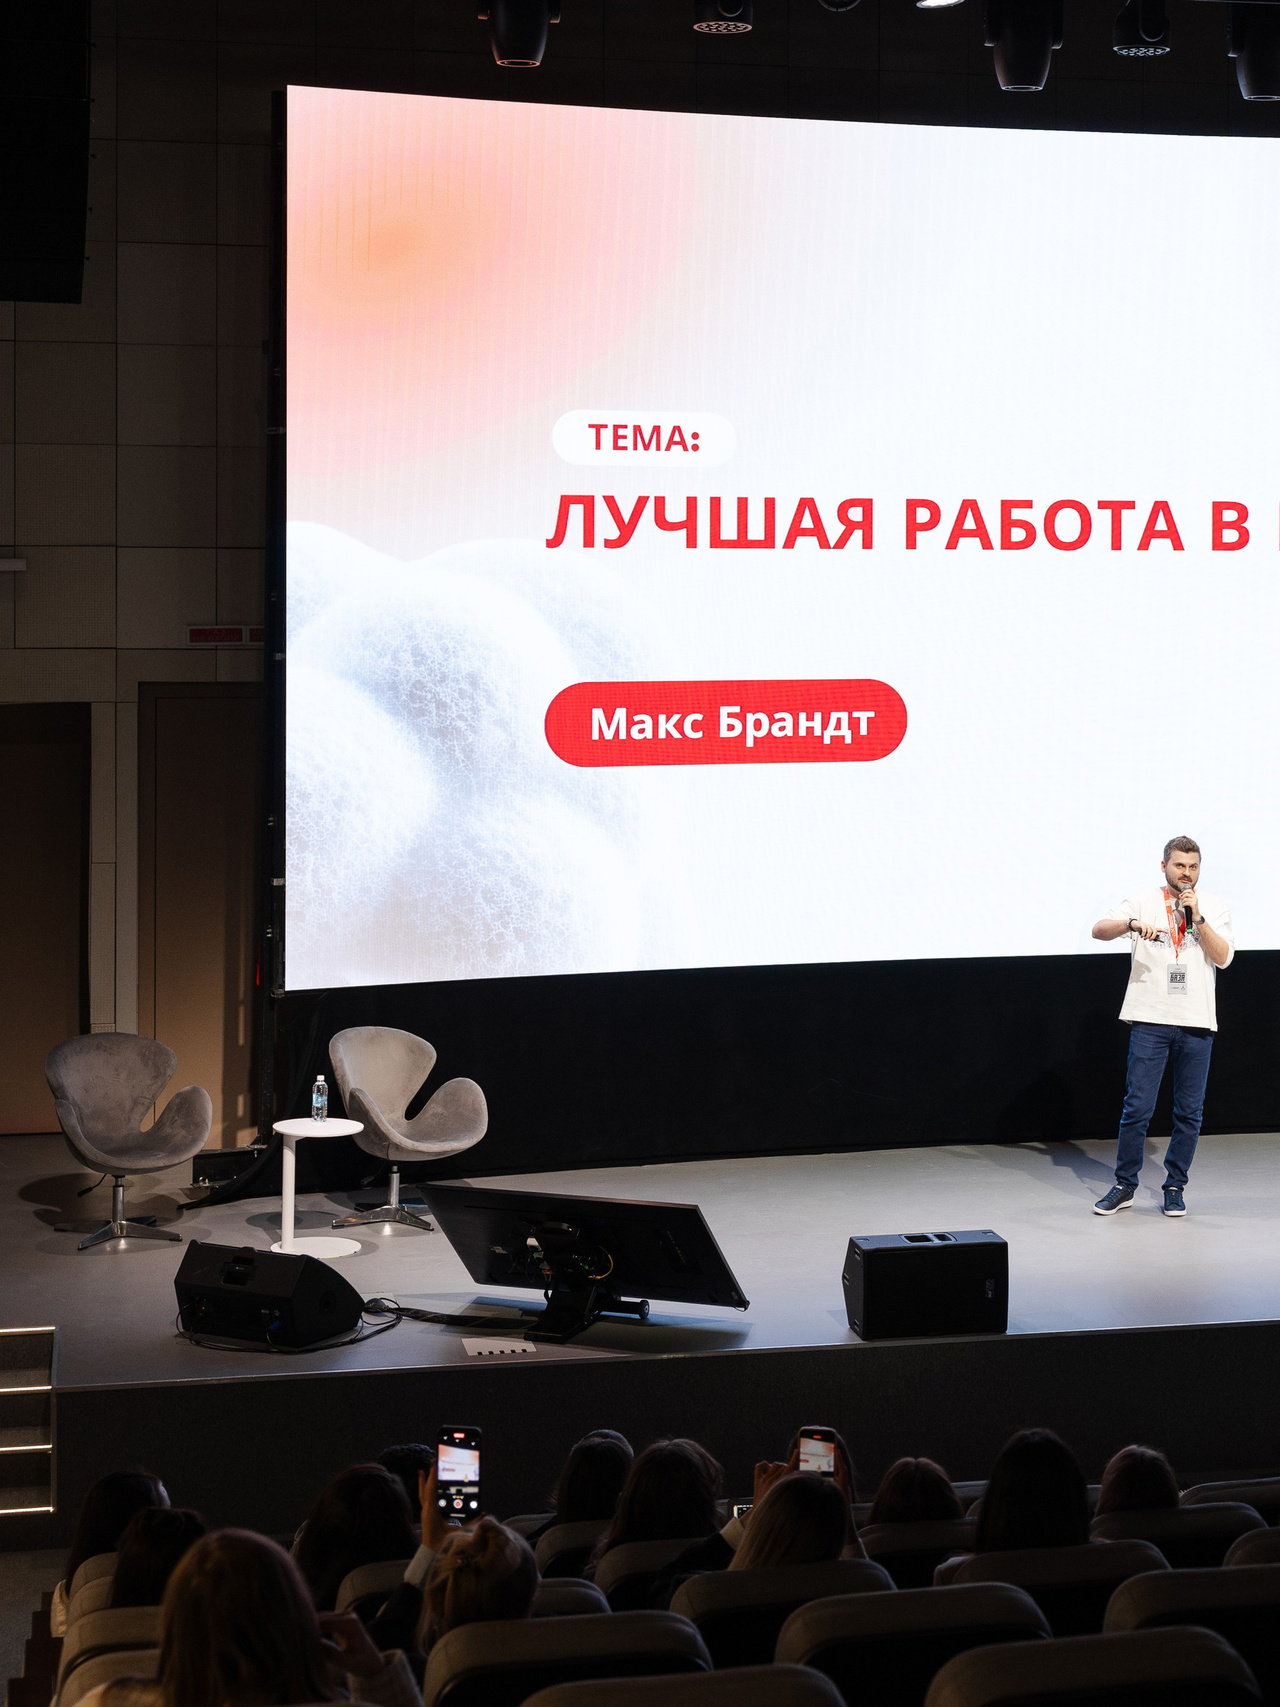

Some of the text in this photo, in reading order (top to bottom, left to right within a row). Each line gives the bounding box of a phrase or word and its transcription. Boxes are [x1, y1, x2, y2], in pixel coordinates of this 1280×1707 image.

[588, 424, 700, 452] ТЕМА:
[546, 495, 874, 550] ЛУЧШАЯ
[905, 498, 1185, 552] РАБОТА
[1211, 501, 1251, 552] В
[591, 705, 876, 748] Макс Брандт
